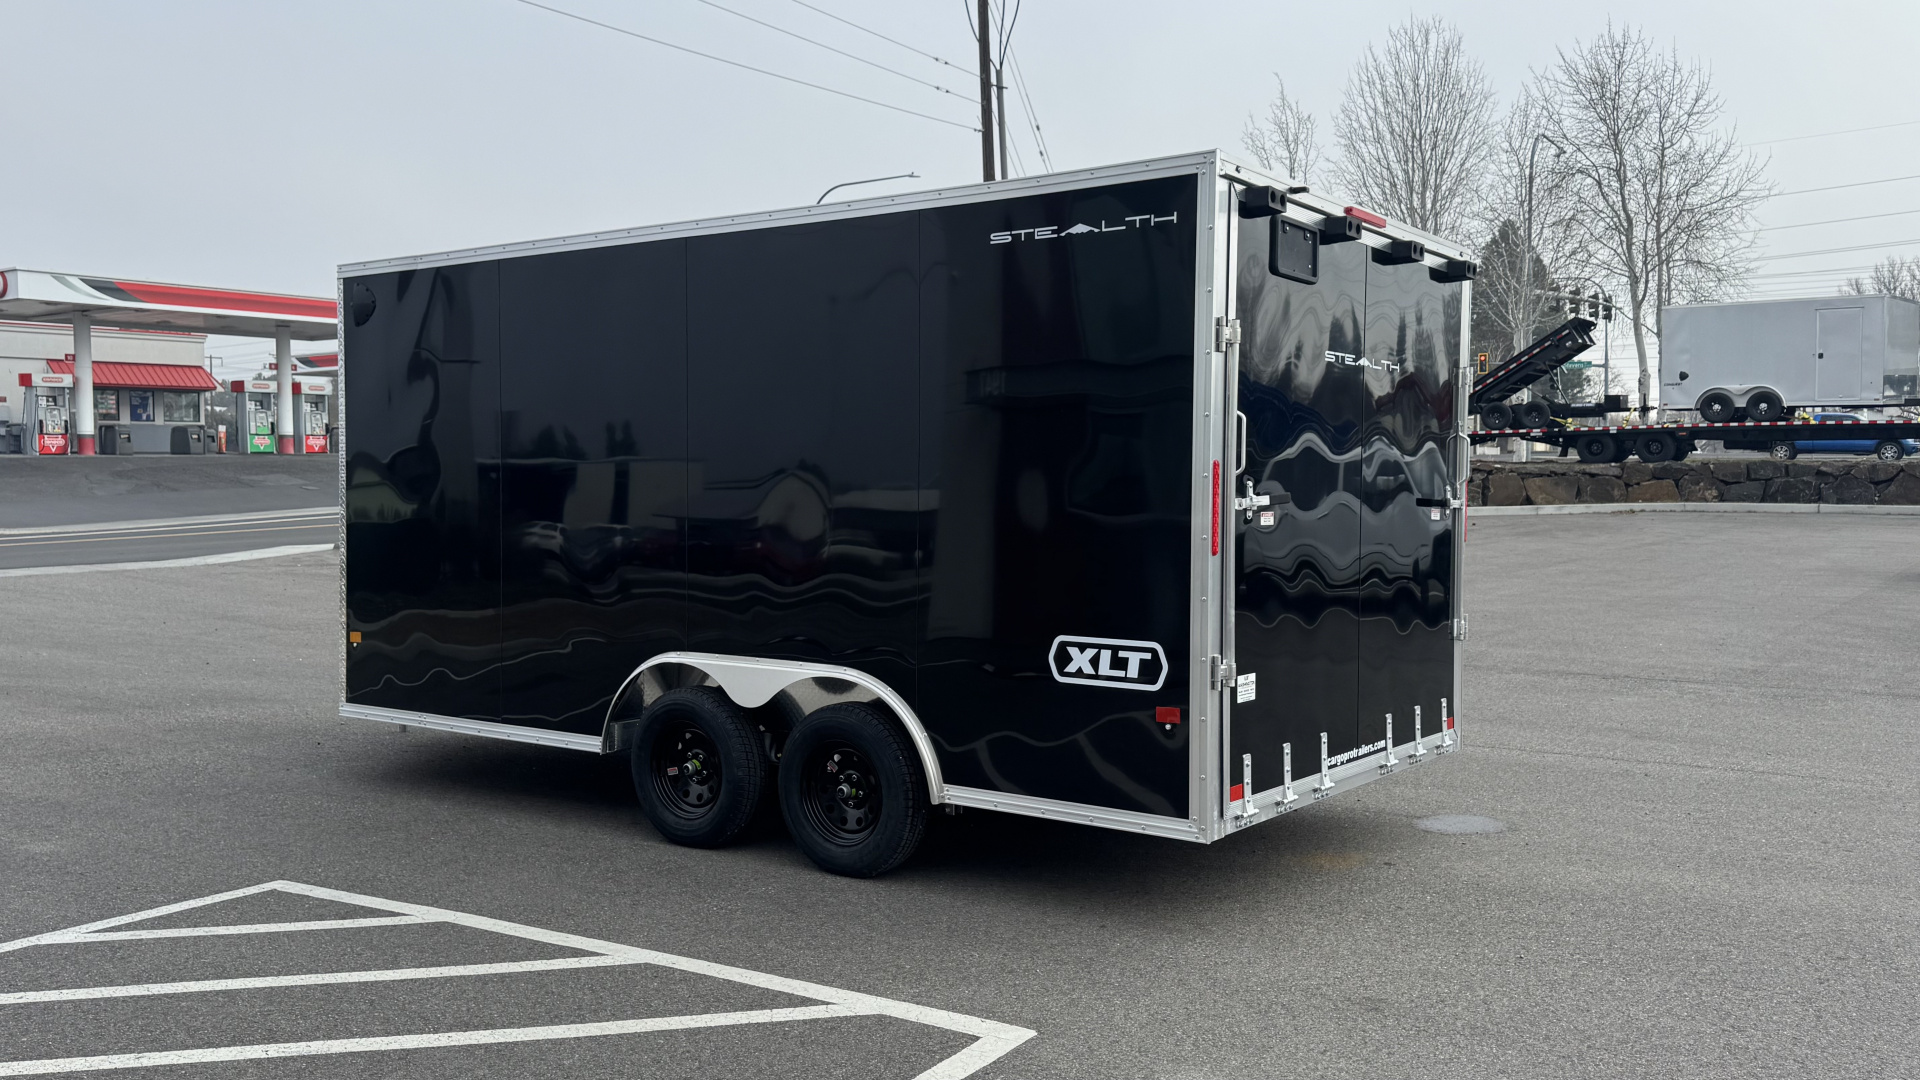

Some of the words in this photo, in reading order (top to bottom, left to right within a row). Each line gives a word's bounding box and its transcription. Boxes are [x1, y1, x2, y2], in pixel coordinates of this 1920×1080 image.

[990, 211, 1177, 244] STEALTH
[1325, 351, 1400, 372] STEALTH
[1063, 646, 1152, 678] XLT
[1327, 740, 1386, 766] cargoprotrailers.com
